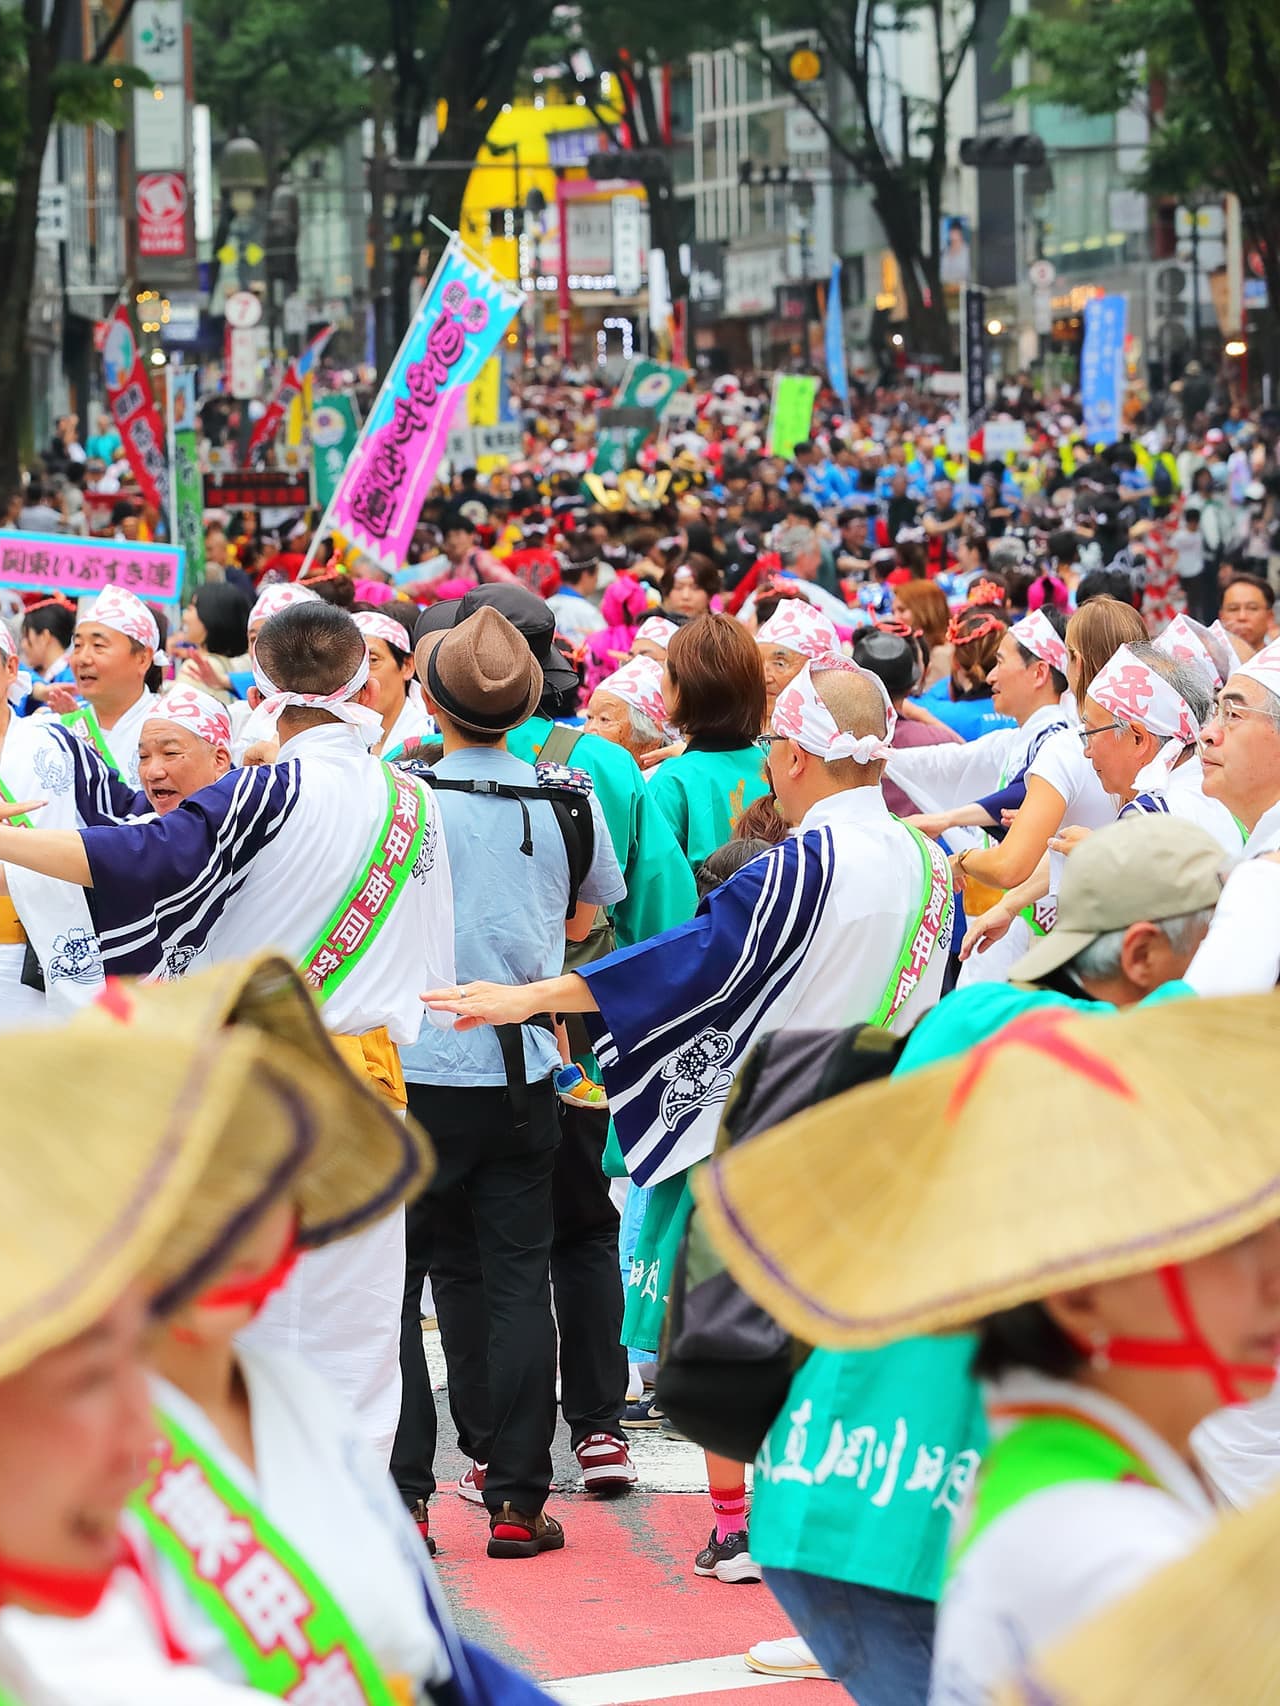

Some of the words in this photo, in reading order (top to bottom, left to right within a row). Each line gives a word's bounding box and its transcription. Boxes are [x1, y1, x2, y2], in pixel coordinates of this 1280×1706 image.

[1, 548, 171, 589] 関東いぶすき連
